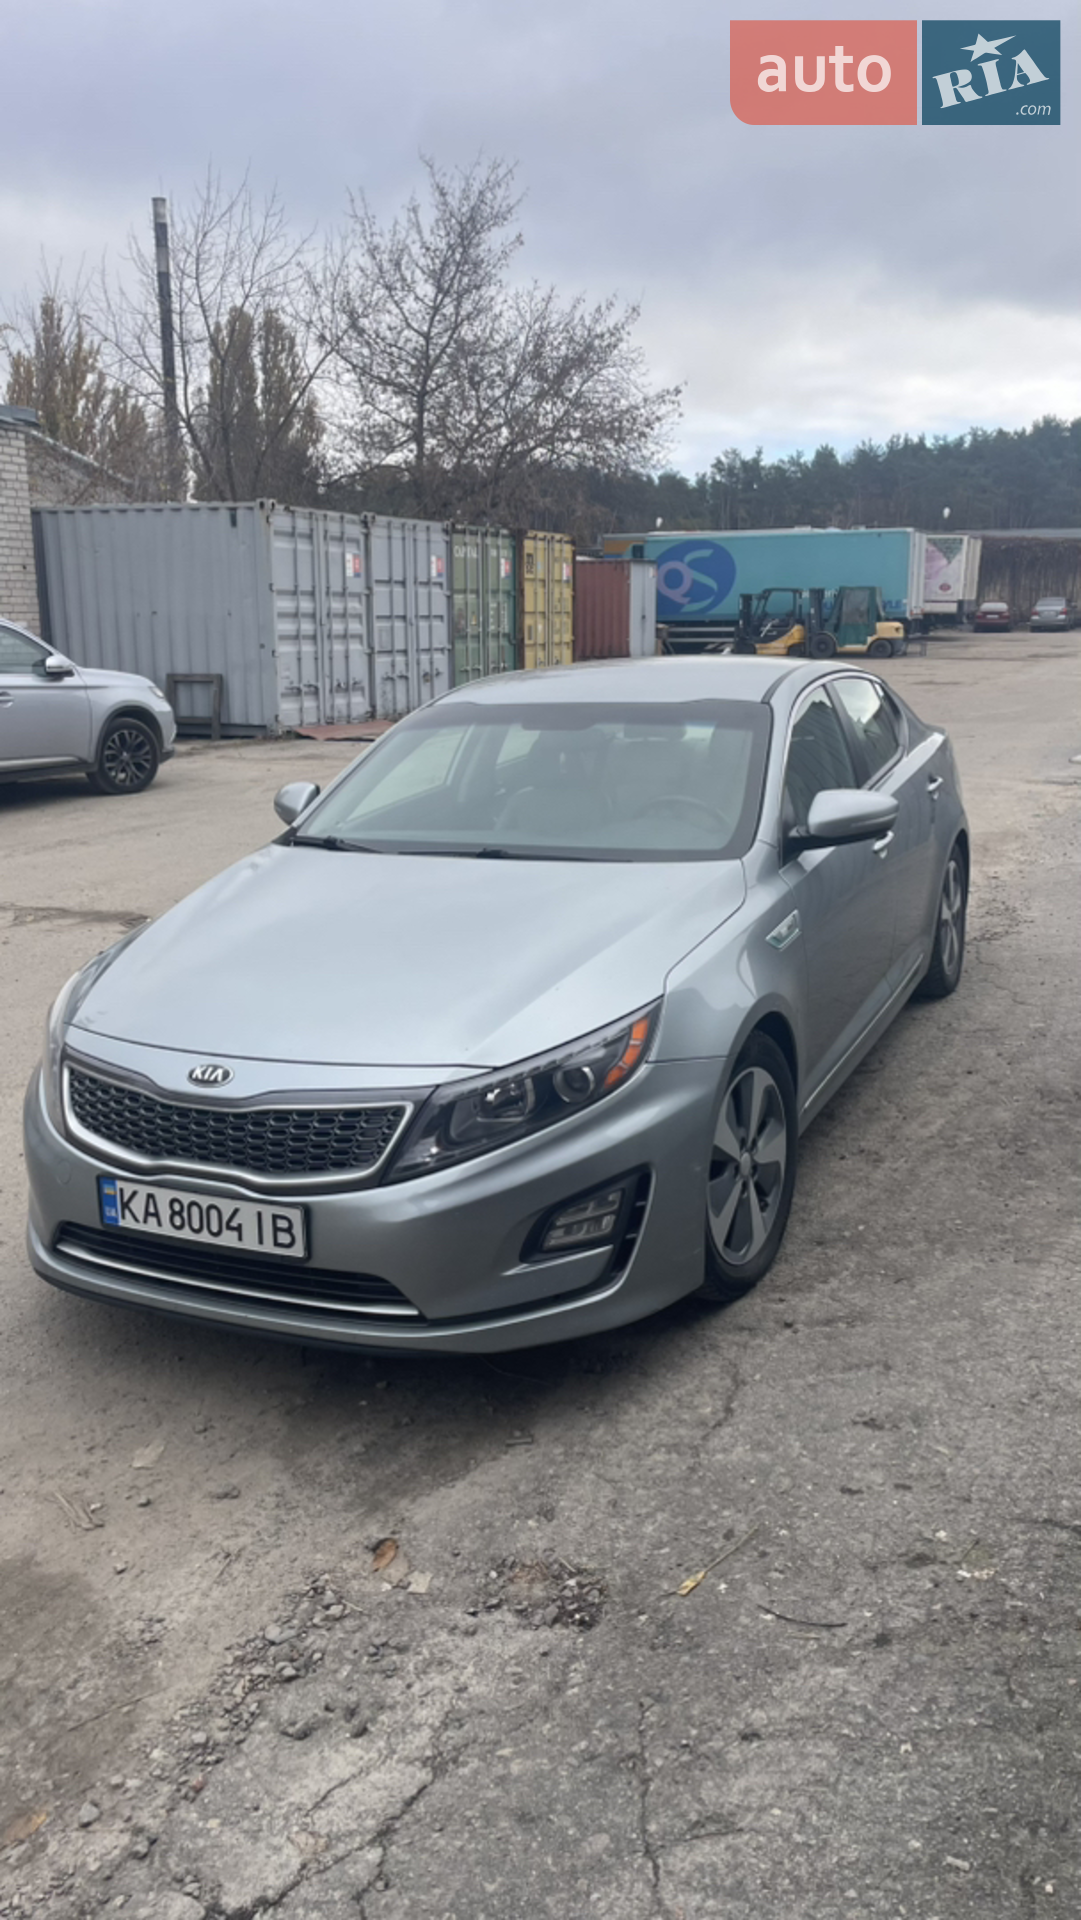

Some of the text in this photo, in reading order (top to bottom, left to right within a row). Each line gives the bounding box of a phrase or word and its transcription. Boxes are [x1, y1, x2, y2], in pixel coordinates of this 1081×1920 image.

[191, 1065, 223, 1081] KIA
[119, 1187, 296, 1249] KA 8004 IB
